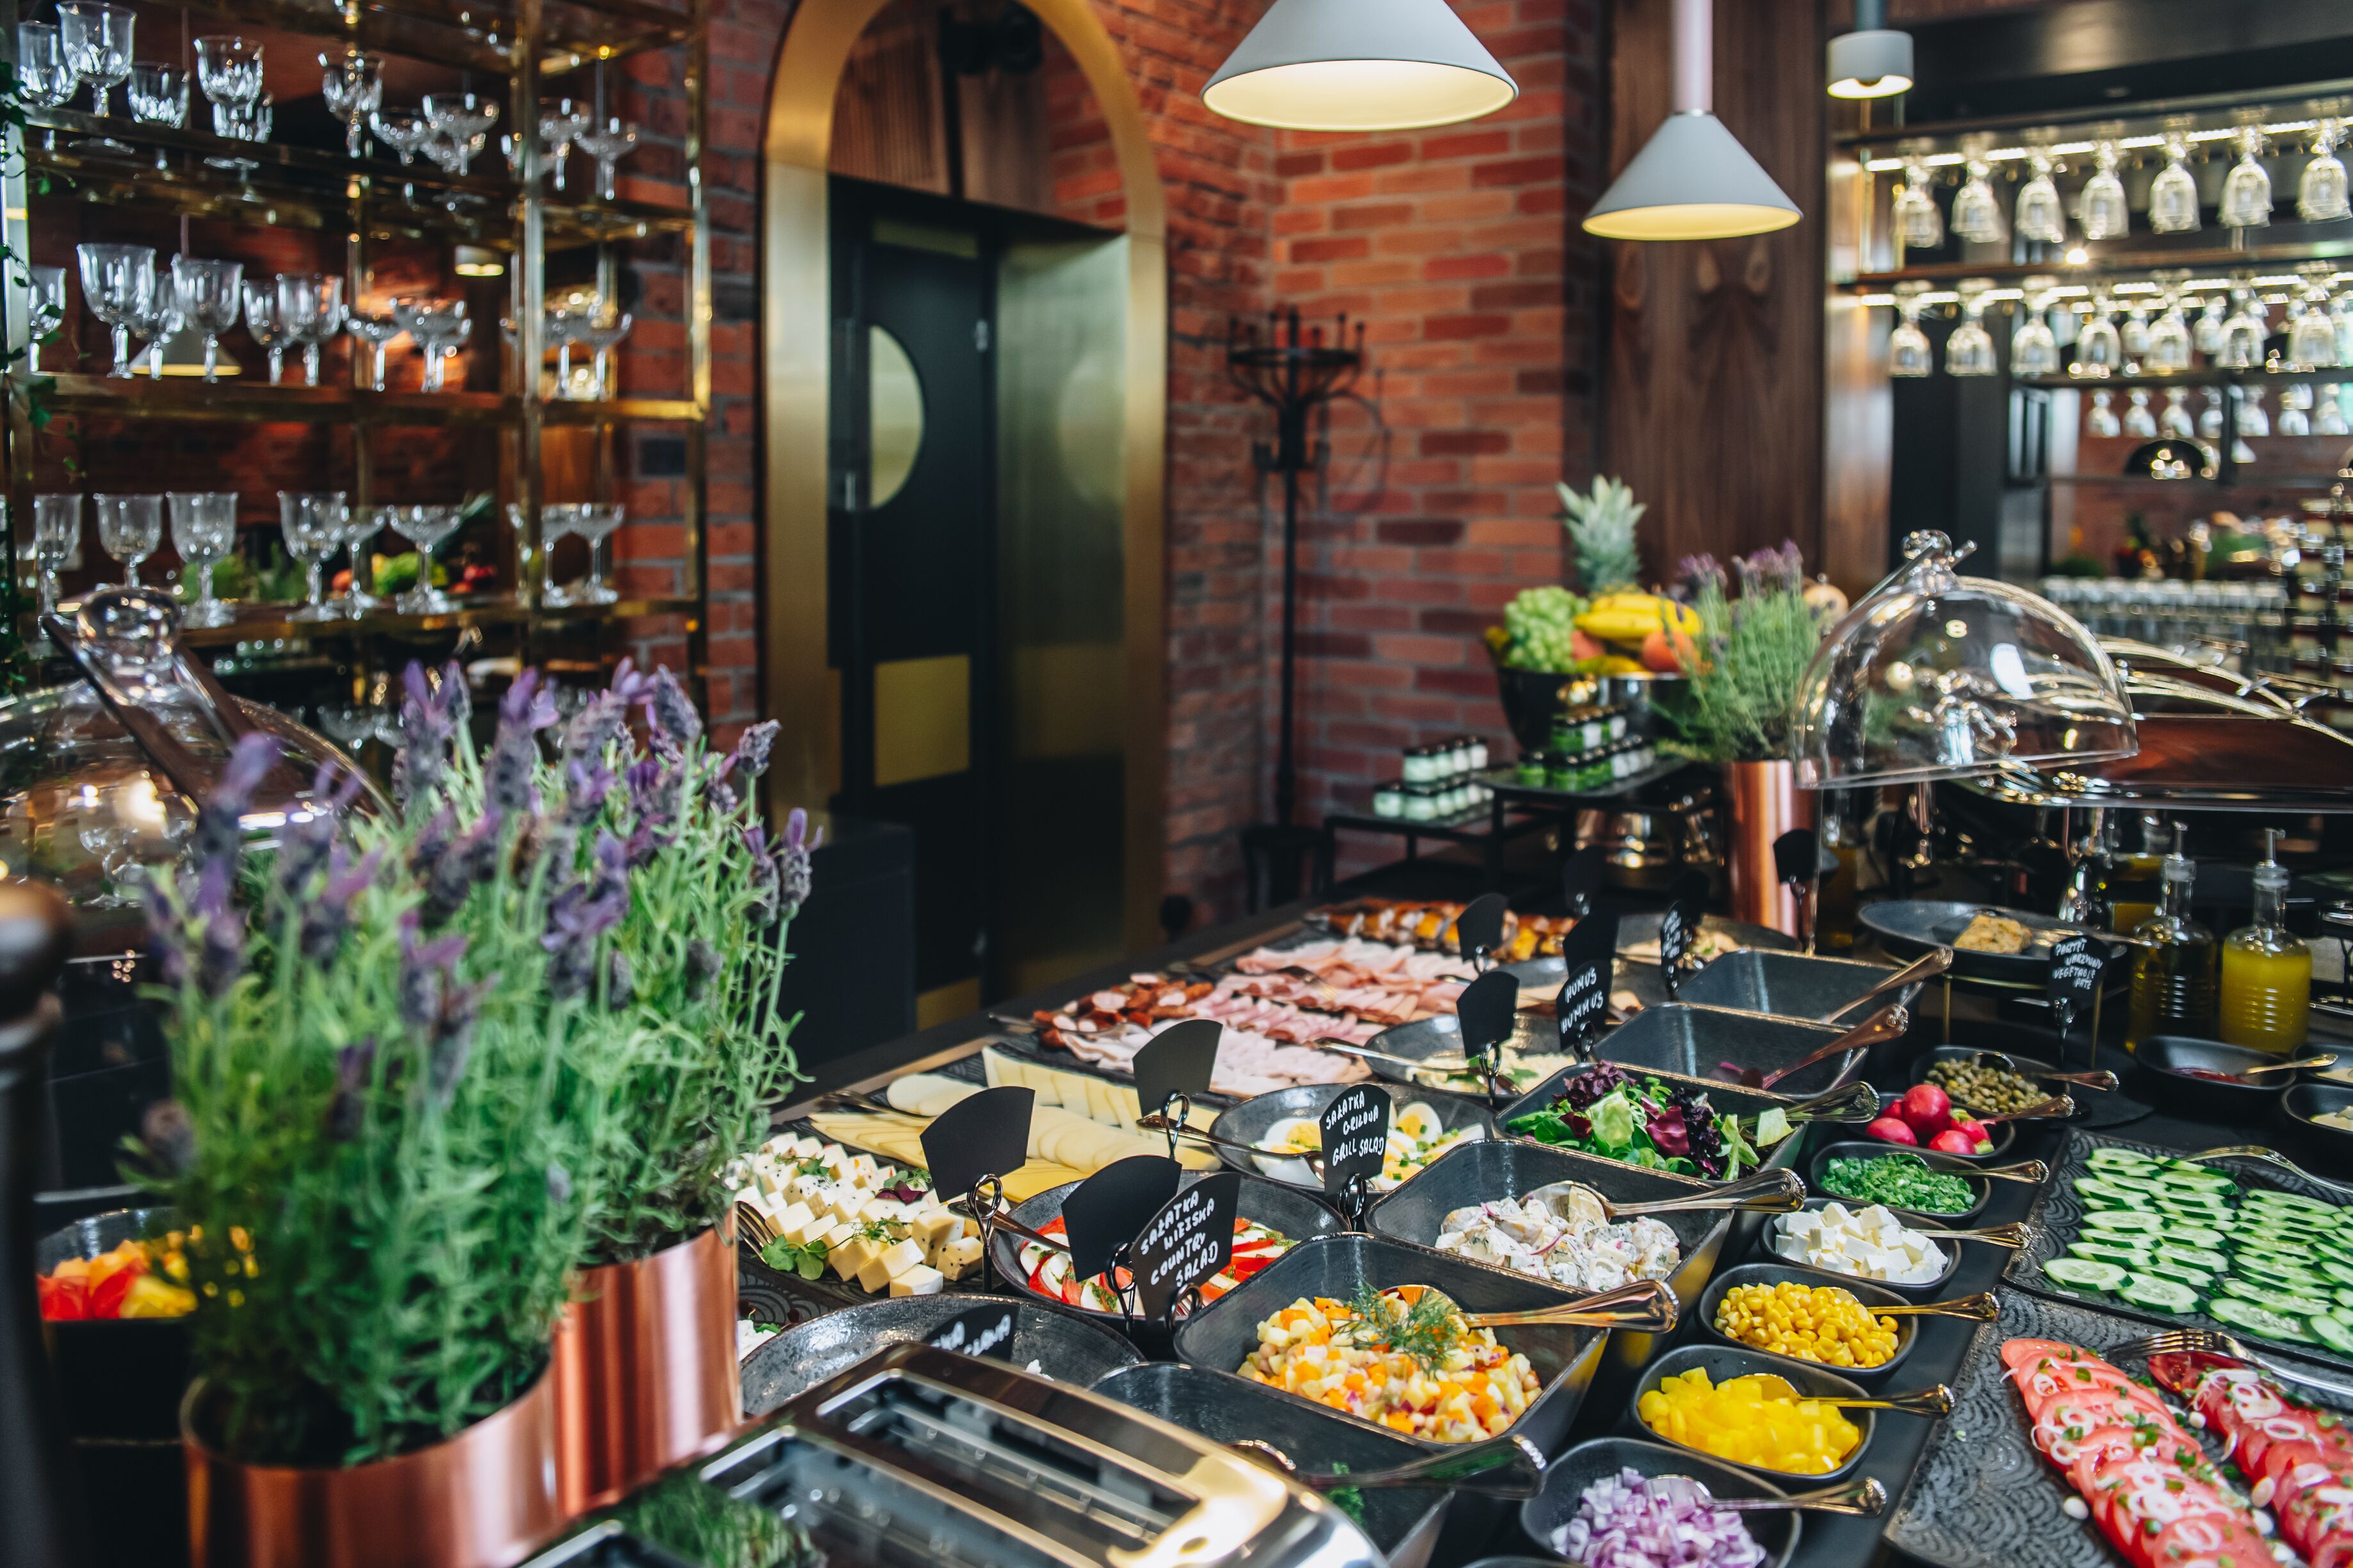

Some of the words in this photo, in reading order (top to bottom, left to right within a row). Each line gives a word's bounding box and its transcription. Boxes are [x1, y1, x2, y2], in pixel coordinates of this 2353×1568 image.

[1565, 967, 1597, 1003] HUMUS
[2074, 978, 2092, 990] PATE
[1561, 990, 1604, 1033] HUMMUS
[1326, 1090, 1365, 1130] SAŁATKA
[1332, 1138, 1357, 1167] GRILL
[1358, 1136, 1385, 1158] SALAD
[1140, 1190, 1200, 1255] SAŁATKA
[1163, 1197, 1215, 1250] WIEJSKA
[1150, 1232, 1206, 1286] COUNTRY
[1175, 1240, 1219, 1288] SALAD
